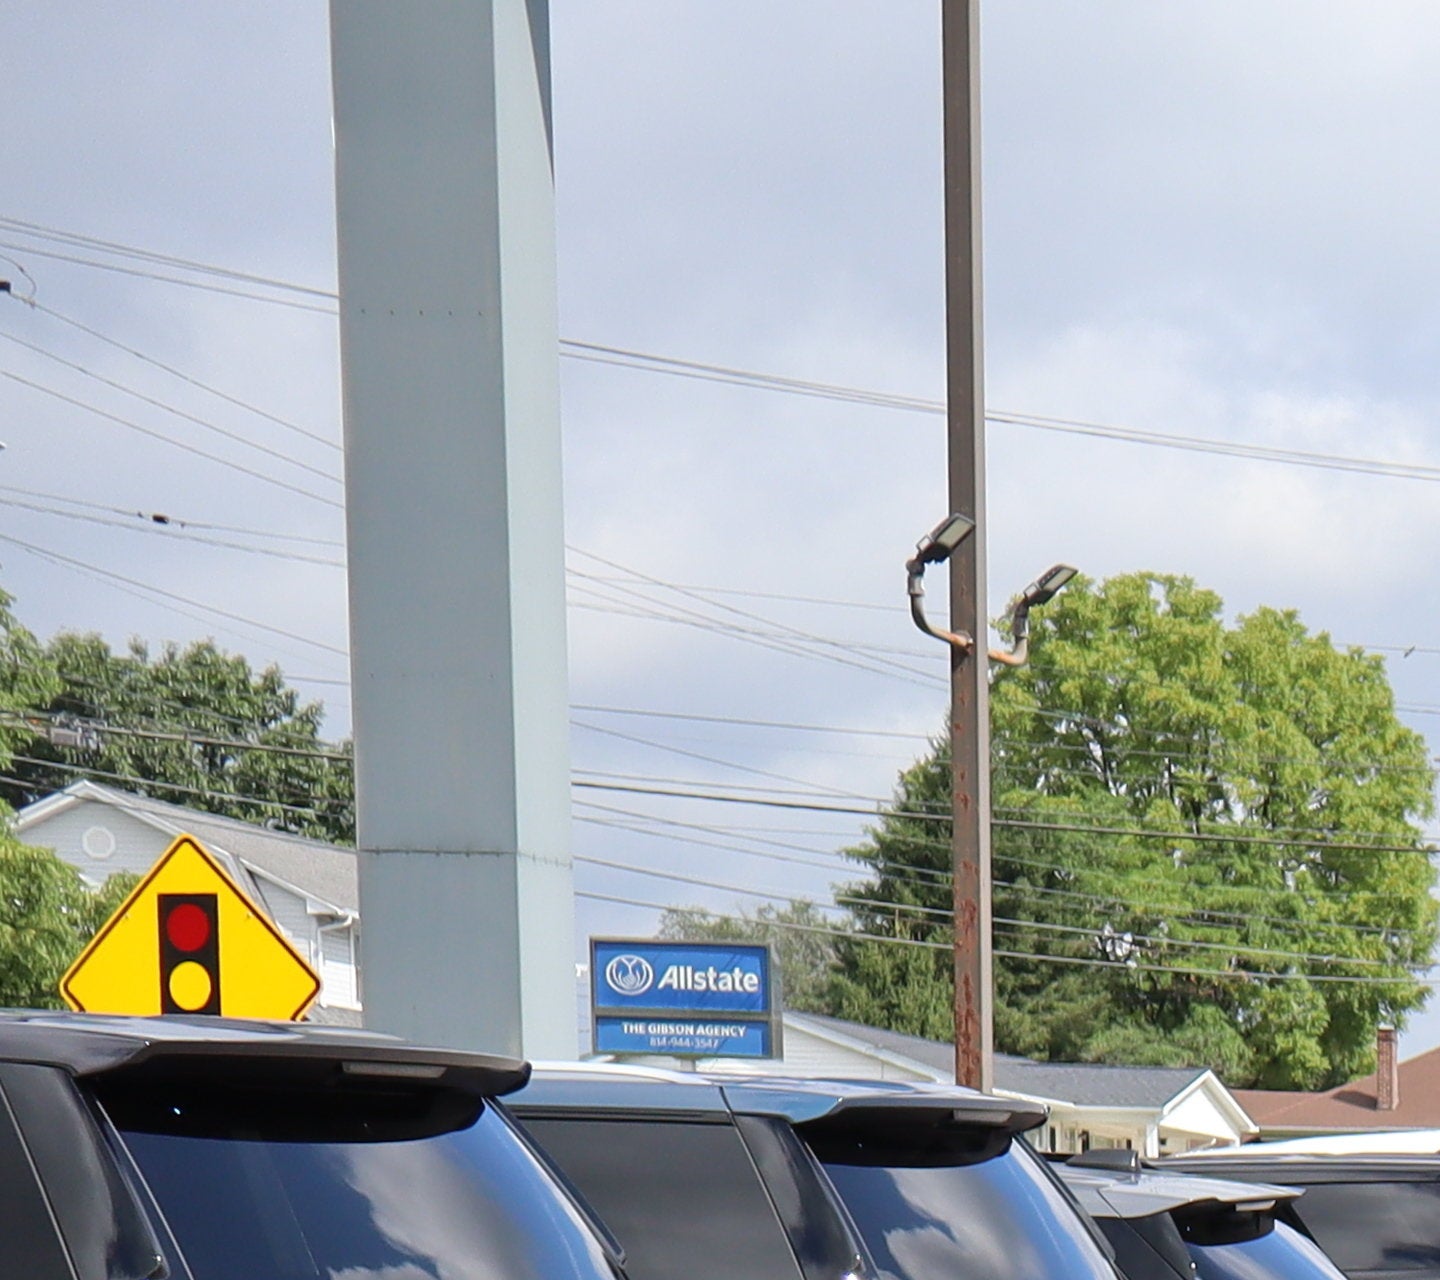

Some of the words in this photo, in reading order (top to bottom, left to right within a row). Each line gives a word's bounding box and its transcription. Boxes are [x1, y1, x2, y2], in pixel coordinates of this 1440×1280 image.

[658, 965, 760, 993] Allstate
[622, 1022, 646, 1035] THE
[648, 1023, 694, 1036] GIBSON
[696, 1024, 747, 1038] AGENCY
